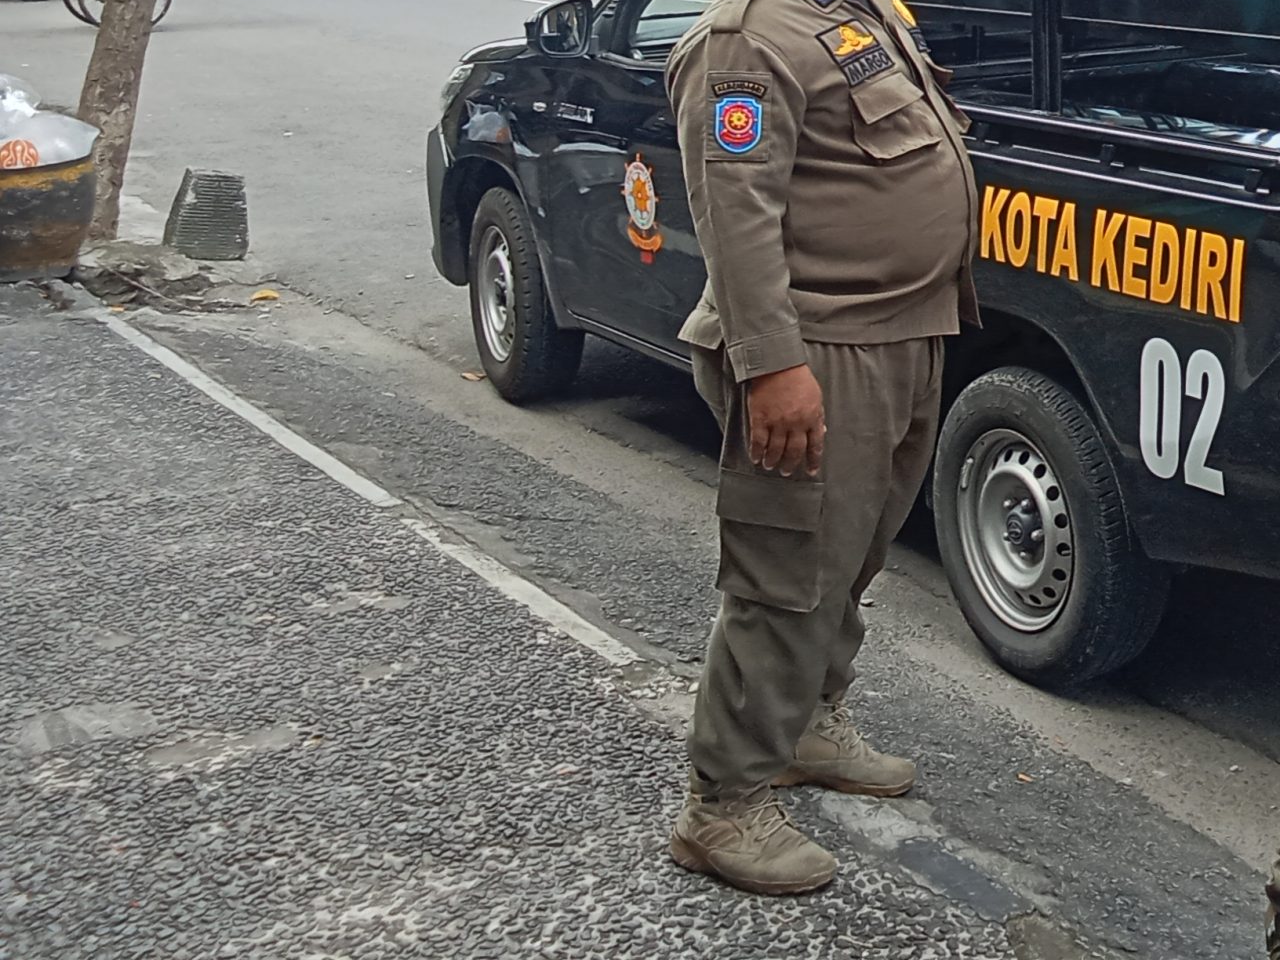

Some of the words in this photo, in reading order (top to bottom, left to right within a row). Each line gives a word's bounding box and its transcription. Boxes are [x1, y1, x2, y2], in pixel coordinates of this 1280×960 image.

[847, 50, 890, 82] MARGO
[980, 185, 1079, 282] KOTA
[1090, 208, 1245, 323] KEDIRI
[1139, 337, 1226, 497] 02
